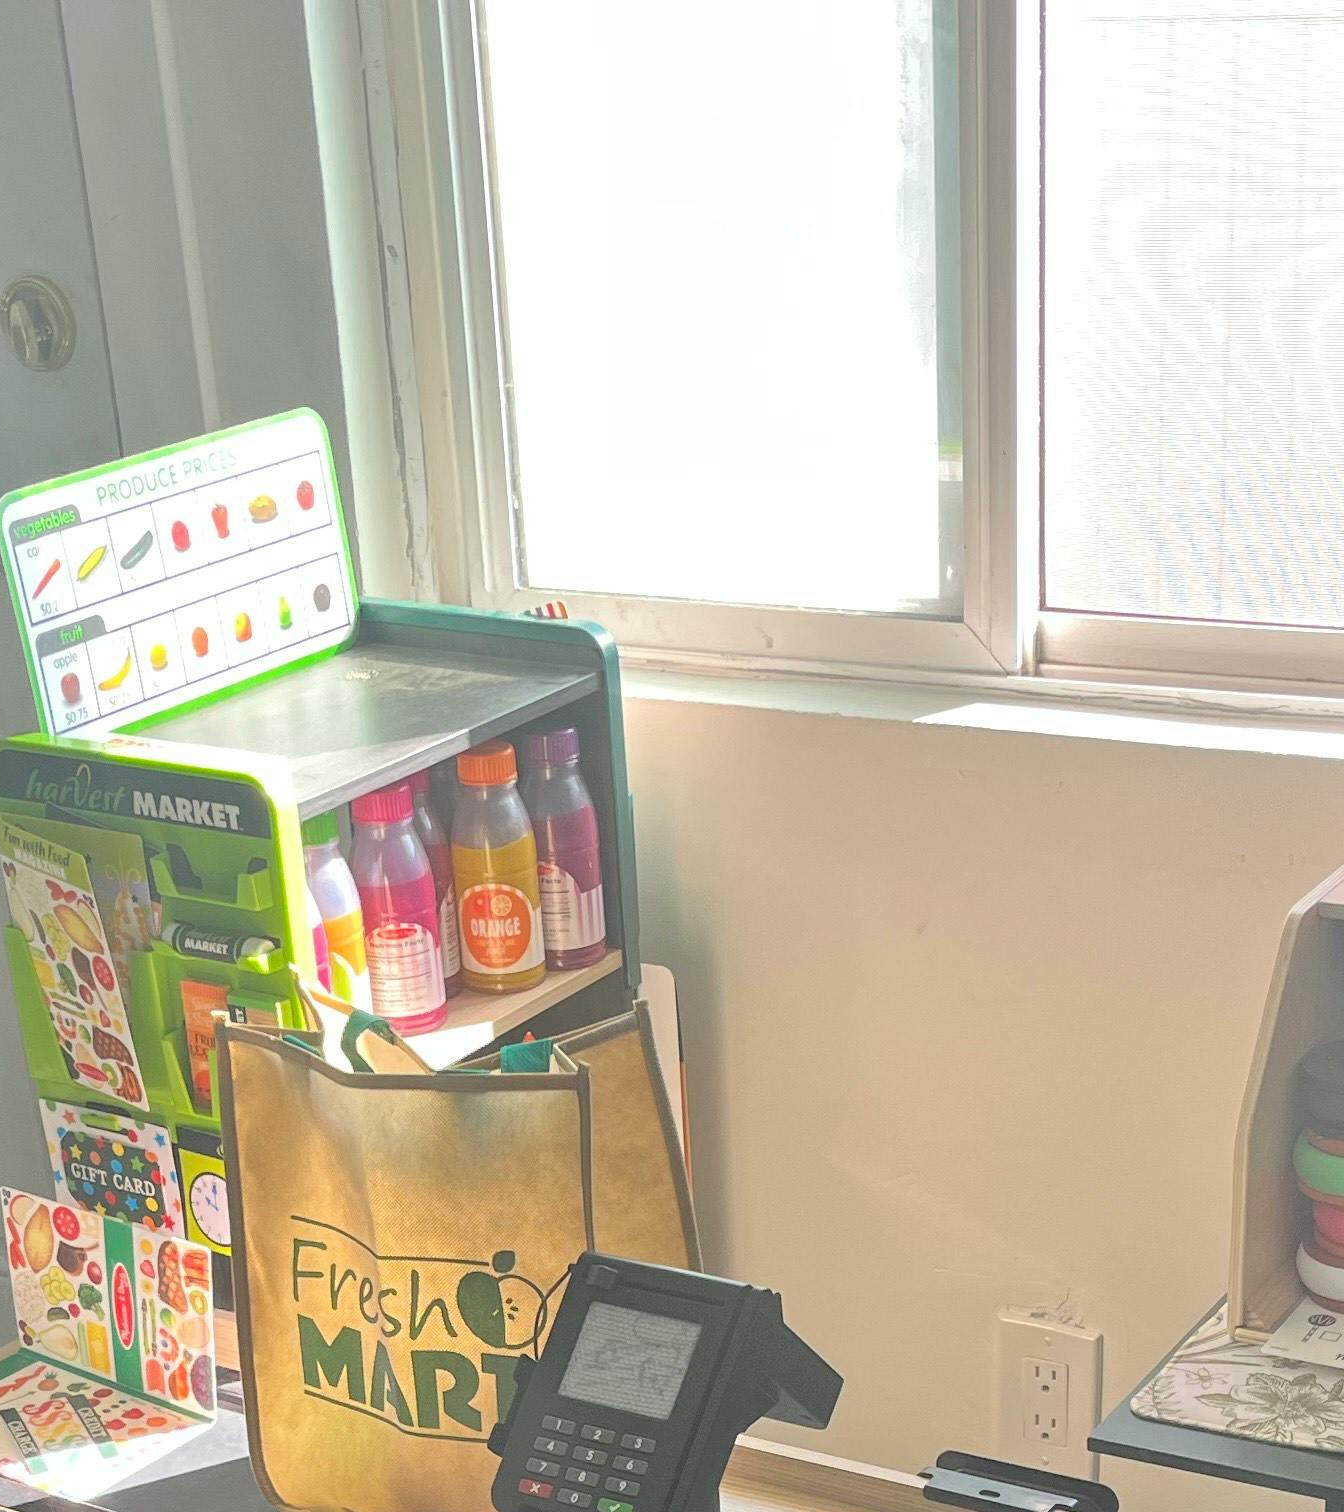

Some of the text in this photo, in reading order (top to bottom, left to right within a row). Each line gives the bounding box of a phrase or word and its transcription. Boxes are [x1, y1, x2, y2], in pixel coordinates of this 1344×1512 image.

[96, 446, 238, 506] PRODUCE PRICES
[14, 510, 76, 538] vegetables
[59, 624, 84, 644] fruit
[52, 650, 79, 670] apple
[64, 706, 89, 726] $0.75
[26, 763, 241, 831] harvest MARKET
[469, 915, 522, 938] ORANGE
[184, 937, 230, 956] MARKET
[70, 1162, 156, 1198] GIFT CARD
[291, 1237, 458, 1342] Fresh
[296, 1313, 518, 1433] MART
[555, 1419, 562, 1431] 1
[593, 1429, 602, 1441] 2
[634, 1438, 643, 1449] 3
[546, 1440, 555, 1451] 4
[585, 1450, 595, 1461] 5
[626, 1459, 634, 1471] 6
[538, 1462, 548, 1473] 7
[578, 1471, 587, 1482] 8
[619, 1481, 627, 1492] 9
[570, 1492, 579, 1504] 0
